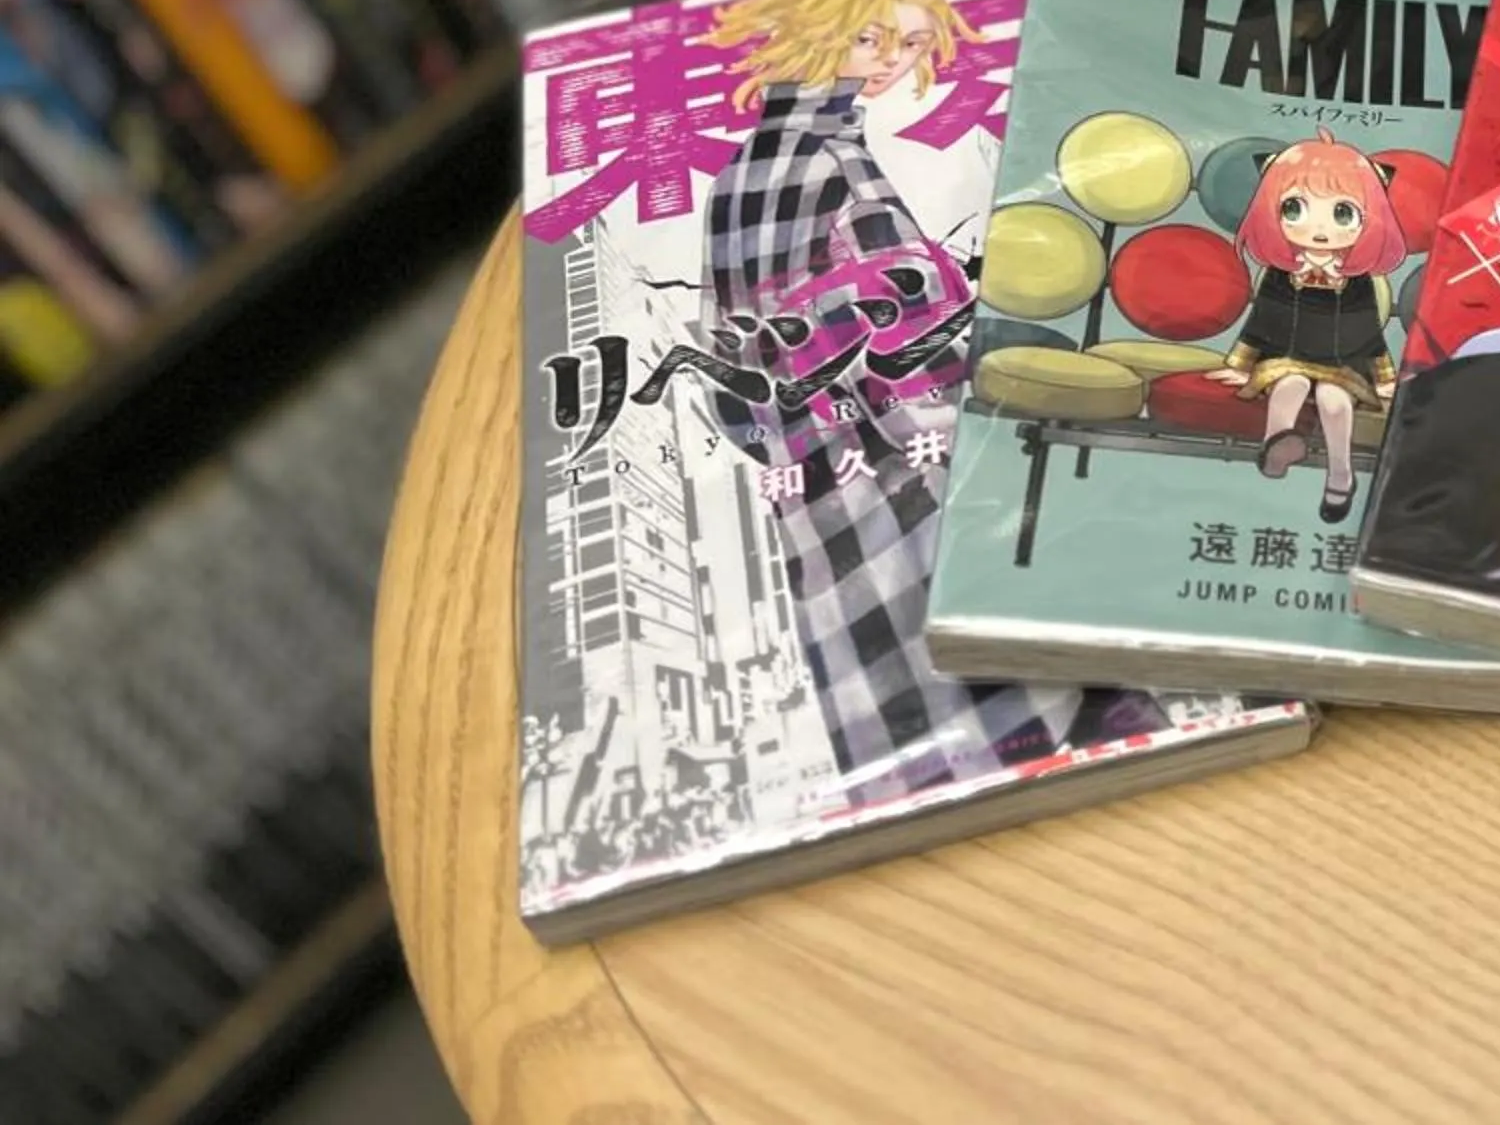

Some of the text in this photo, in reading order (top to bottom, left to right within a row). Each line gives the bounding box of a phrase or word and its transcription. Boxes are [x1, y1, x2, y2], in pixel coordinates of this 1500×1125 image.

[1269, 101, 1404, 125] スパイファミリー
[757, 428, 950, 502] 和久井
[1189, 522, 1361, 576] 遠藤達
[1177, 578, 1258, 604] JUMP
